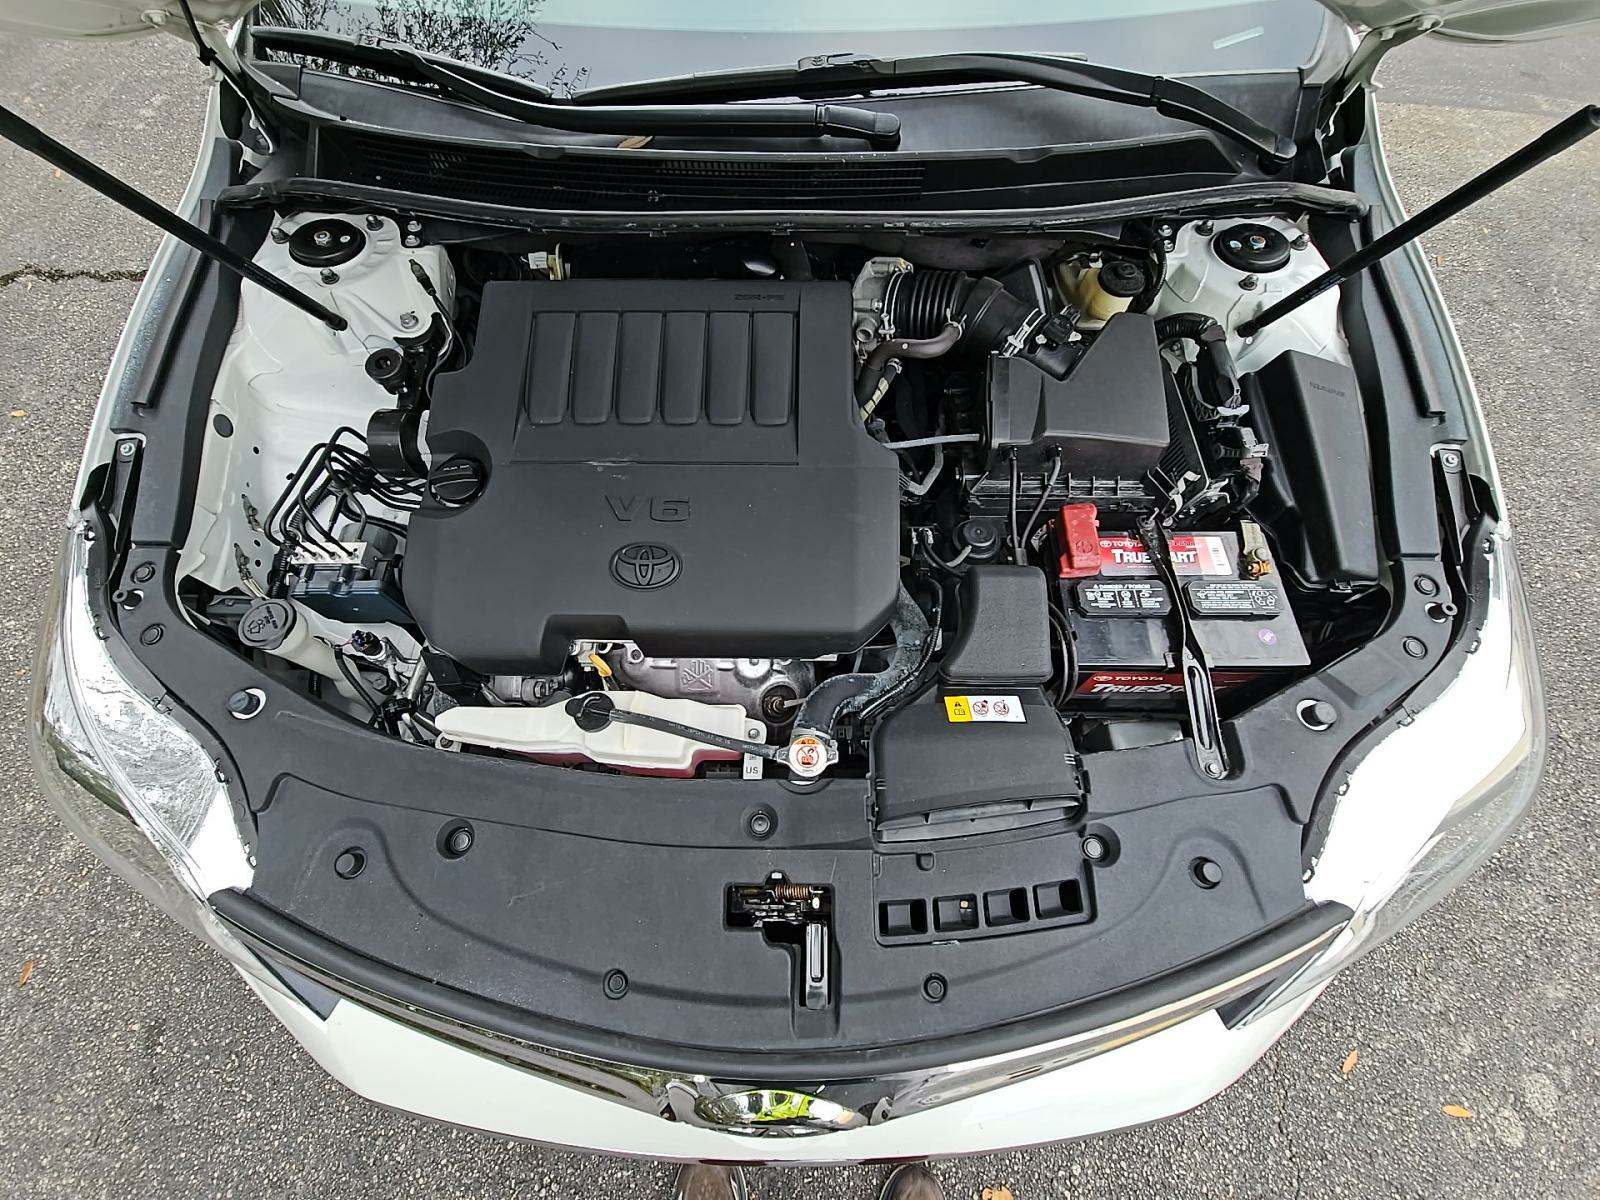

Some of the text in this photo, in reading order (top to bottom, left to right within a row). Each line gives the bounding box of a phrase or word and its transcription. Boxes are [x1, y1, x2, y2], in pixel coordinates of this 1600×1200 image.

[604, 495, 690, 522] V6
[1111, 549, 1197, 563] TRUEART
[745, 766, 759, 774] US
